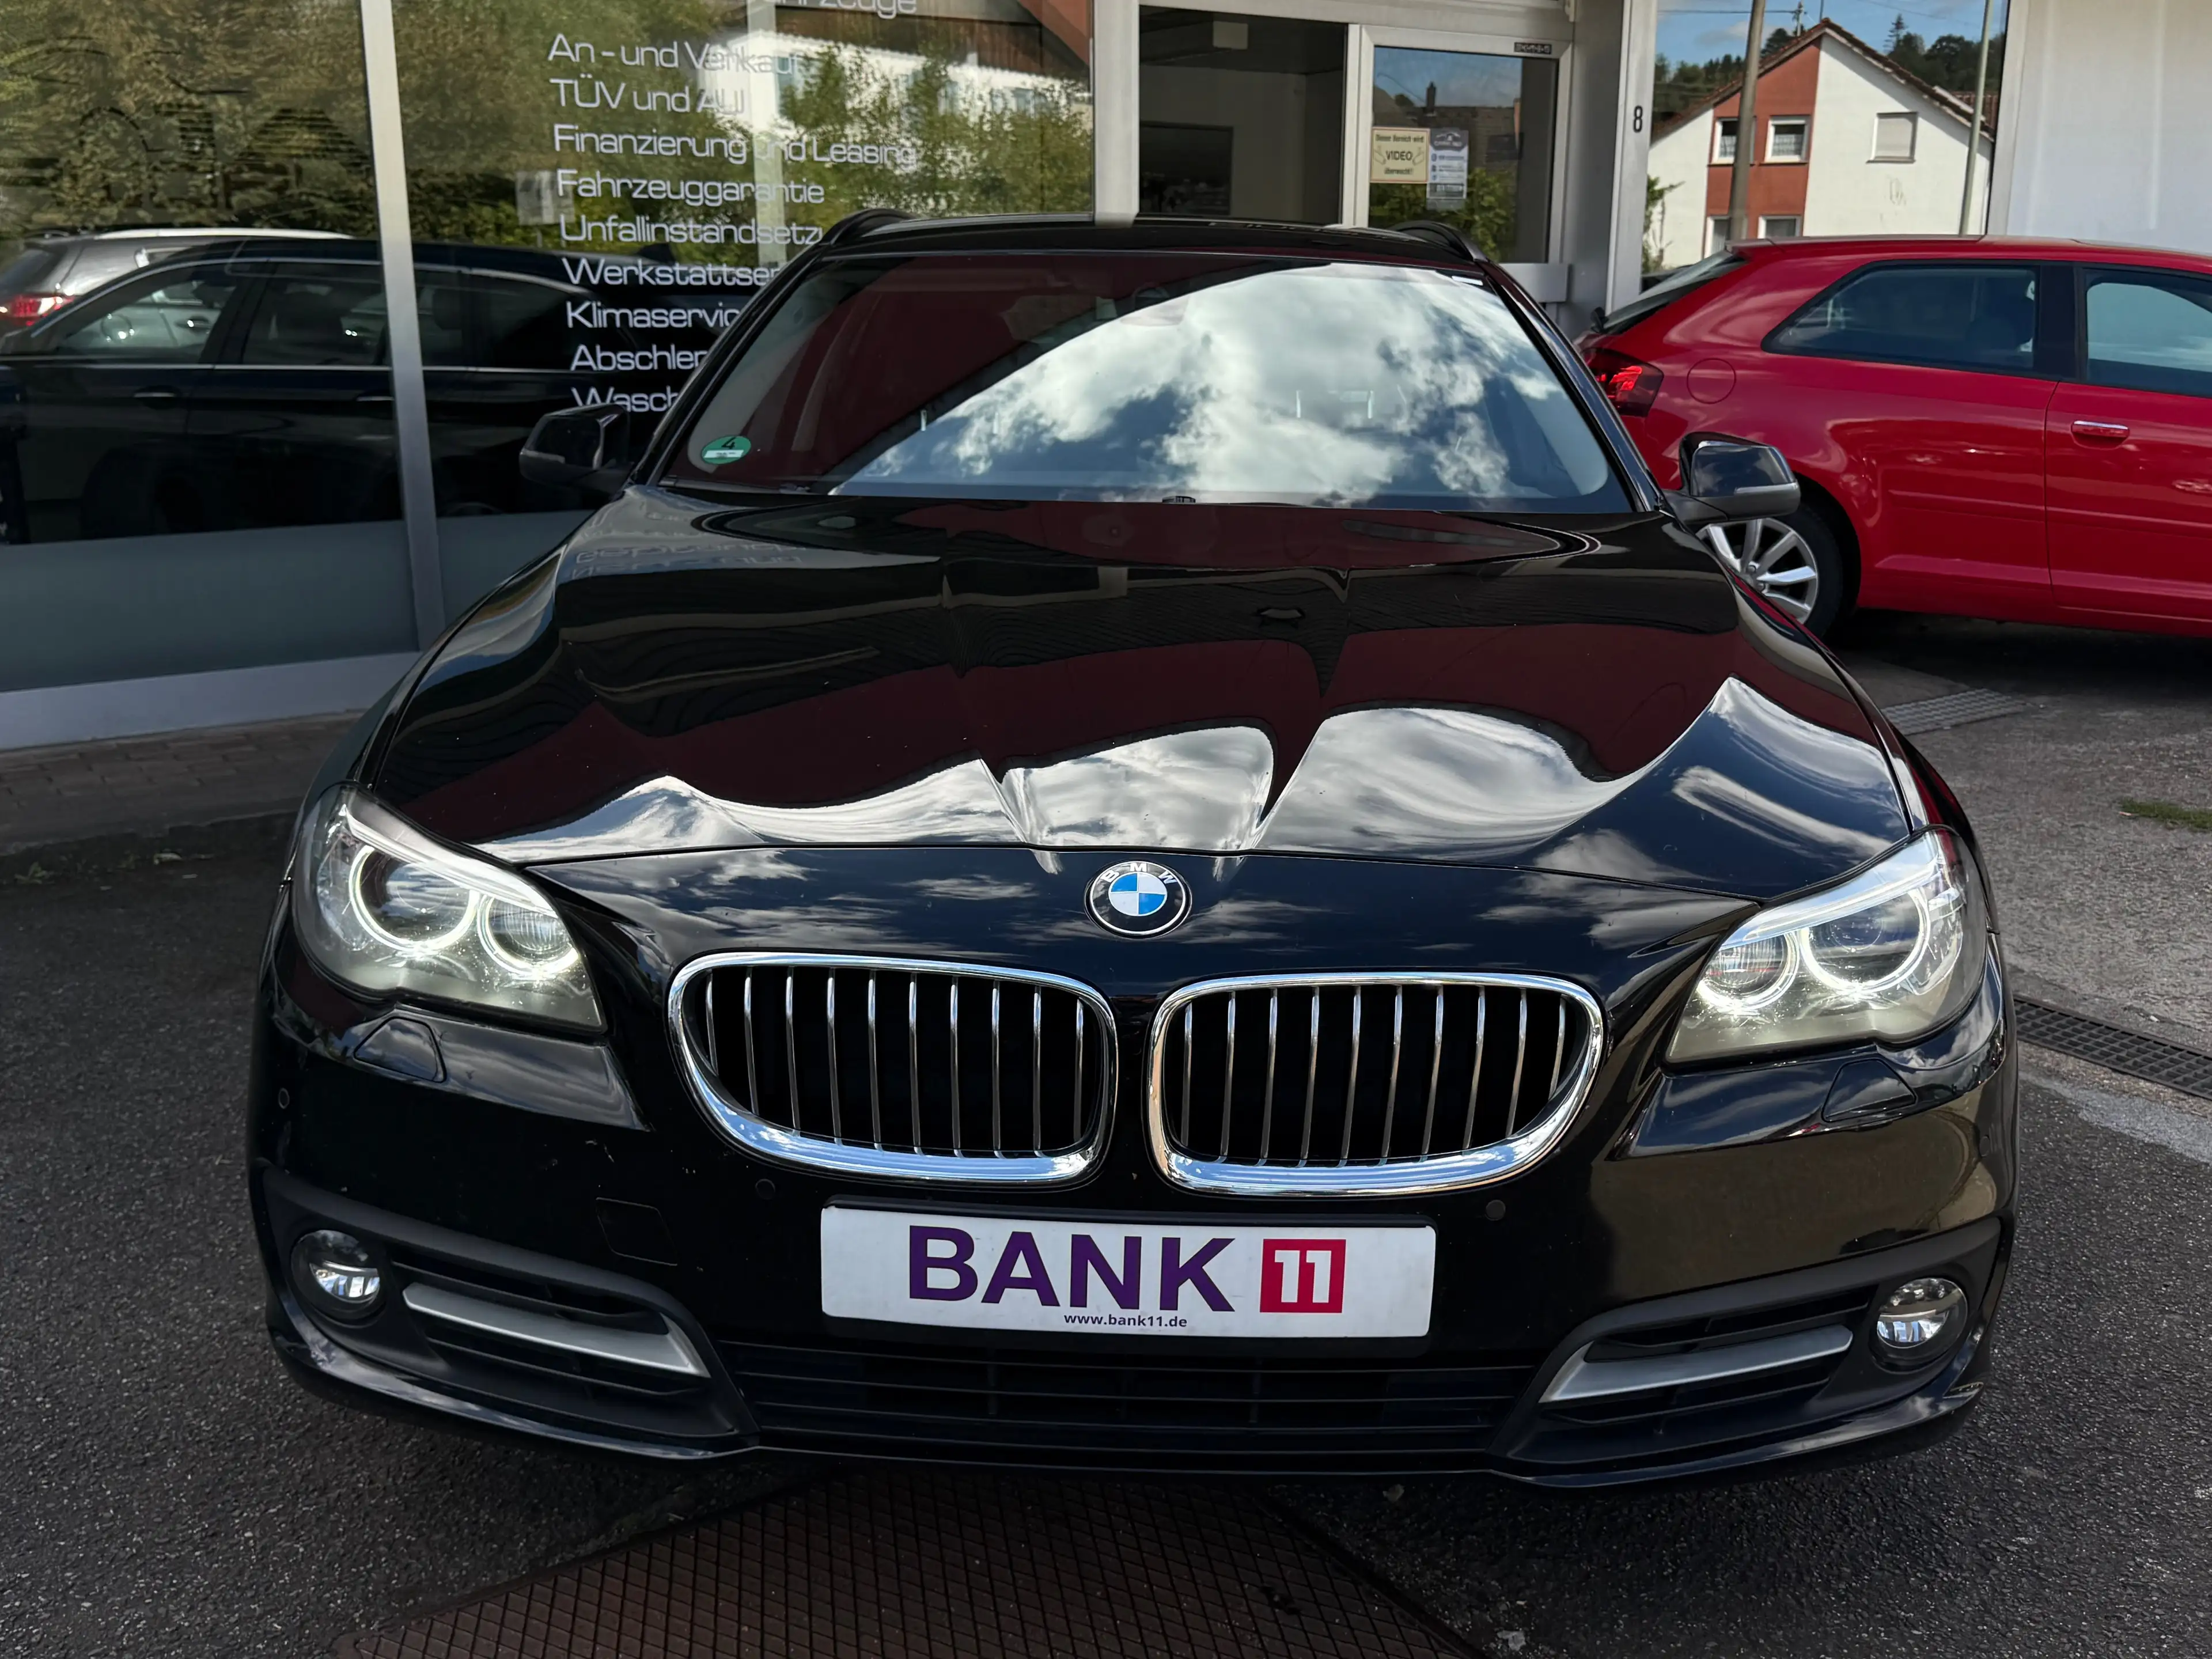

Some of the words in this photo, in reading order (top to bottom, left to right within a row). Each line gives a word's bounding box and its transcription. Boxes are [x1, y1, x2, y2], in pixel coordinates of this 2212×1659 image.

[620, 41, 679, 68] und
[549, 73, 626, 109] TÜV
[633, 86, 690, 112] und
[1633, 105, 1643, 133] 8
[554, 123, 747, 165] Finanzierung
[812, 137, 917, 173] Leasing
[1385, 150, 1413, 161] VIDEO
[556, 169, 825, 207] Fahrzeuggarantie
[721, 436, 736, 449] 4
[1100, 862, 1178, 885] BMW
[908, 1225, 1236, 1313] BANK
[1274, 1249, 1332, 1304] 11
[1064, 1314, 1188, 1327] www.bank11.de
